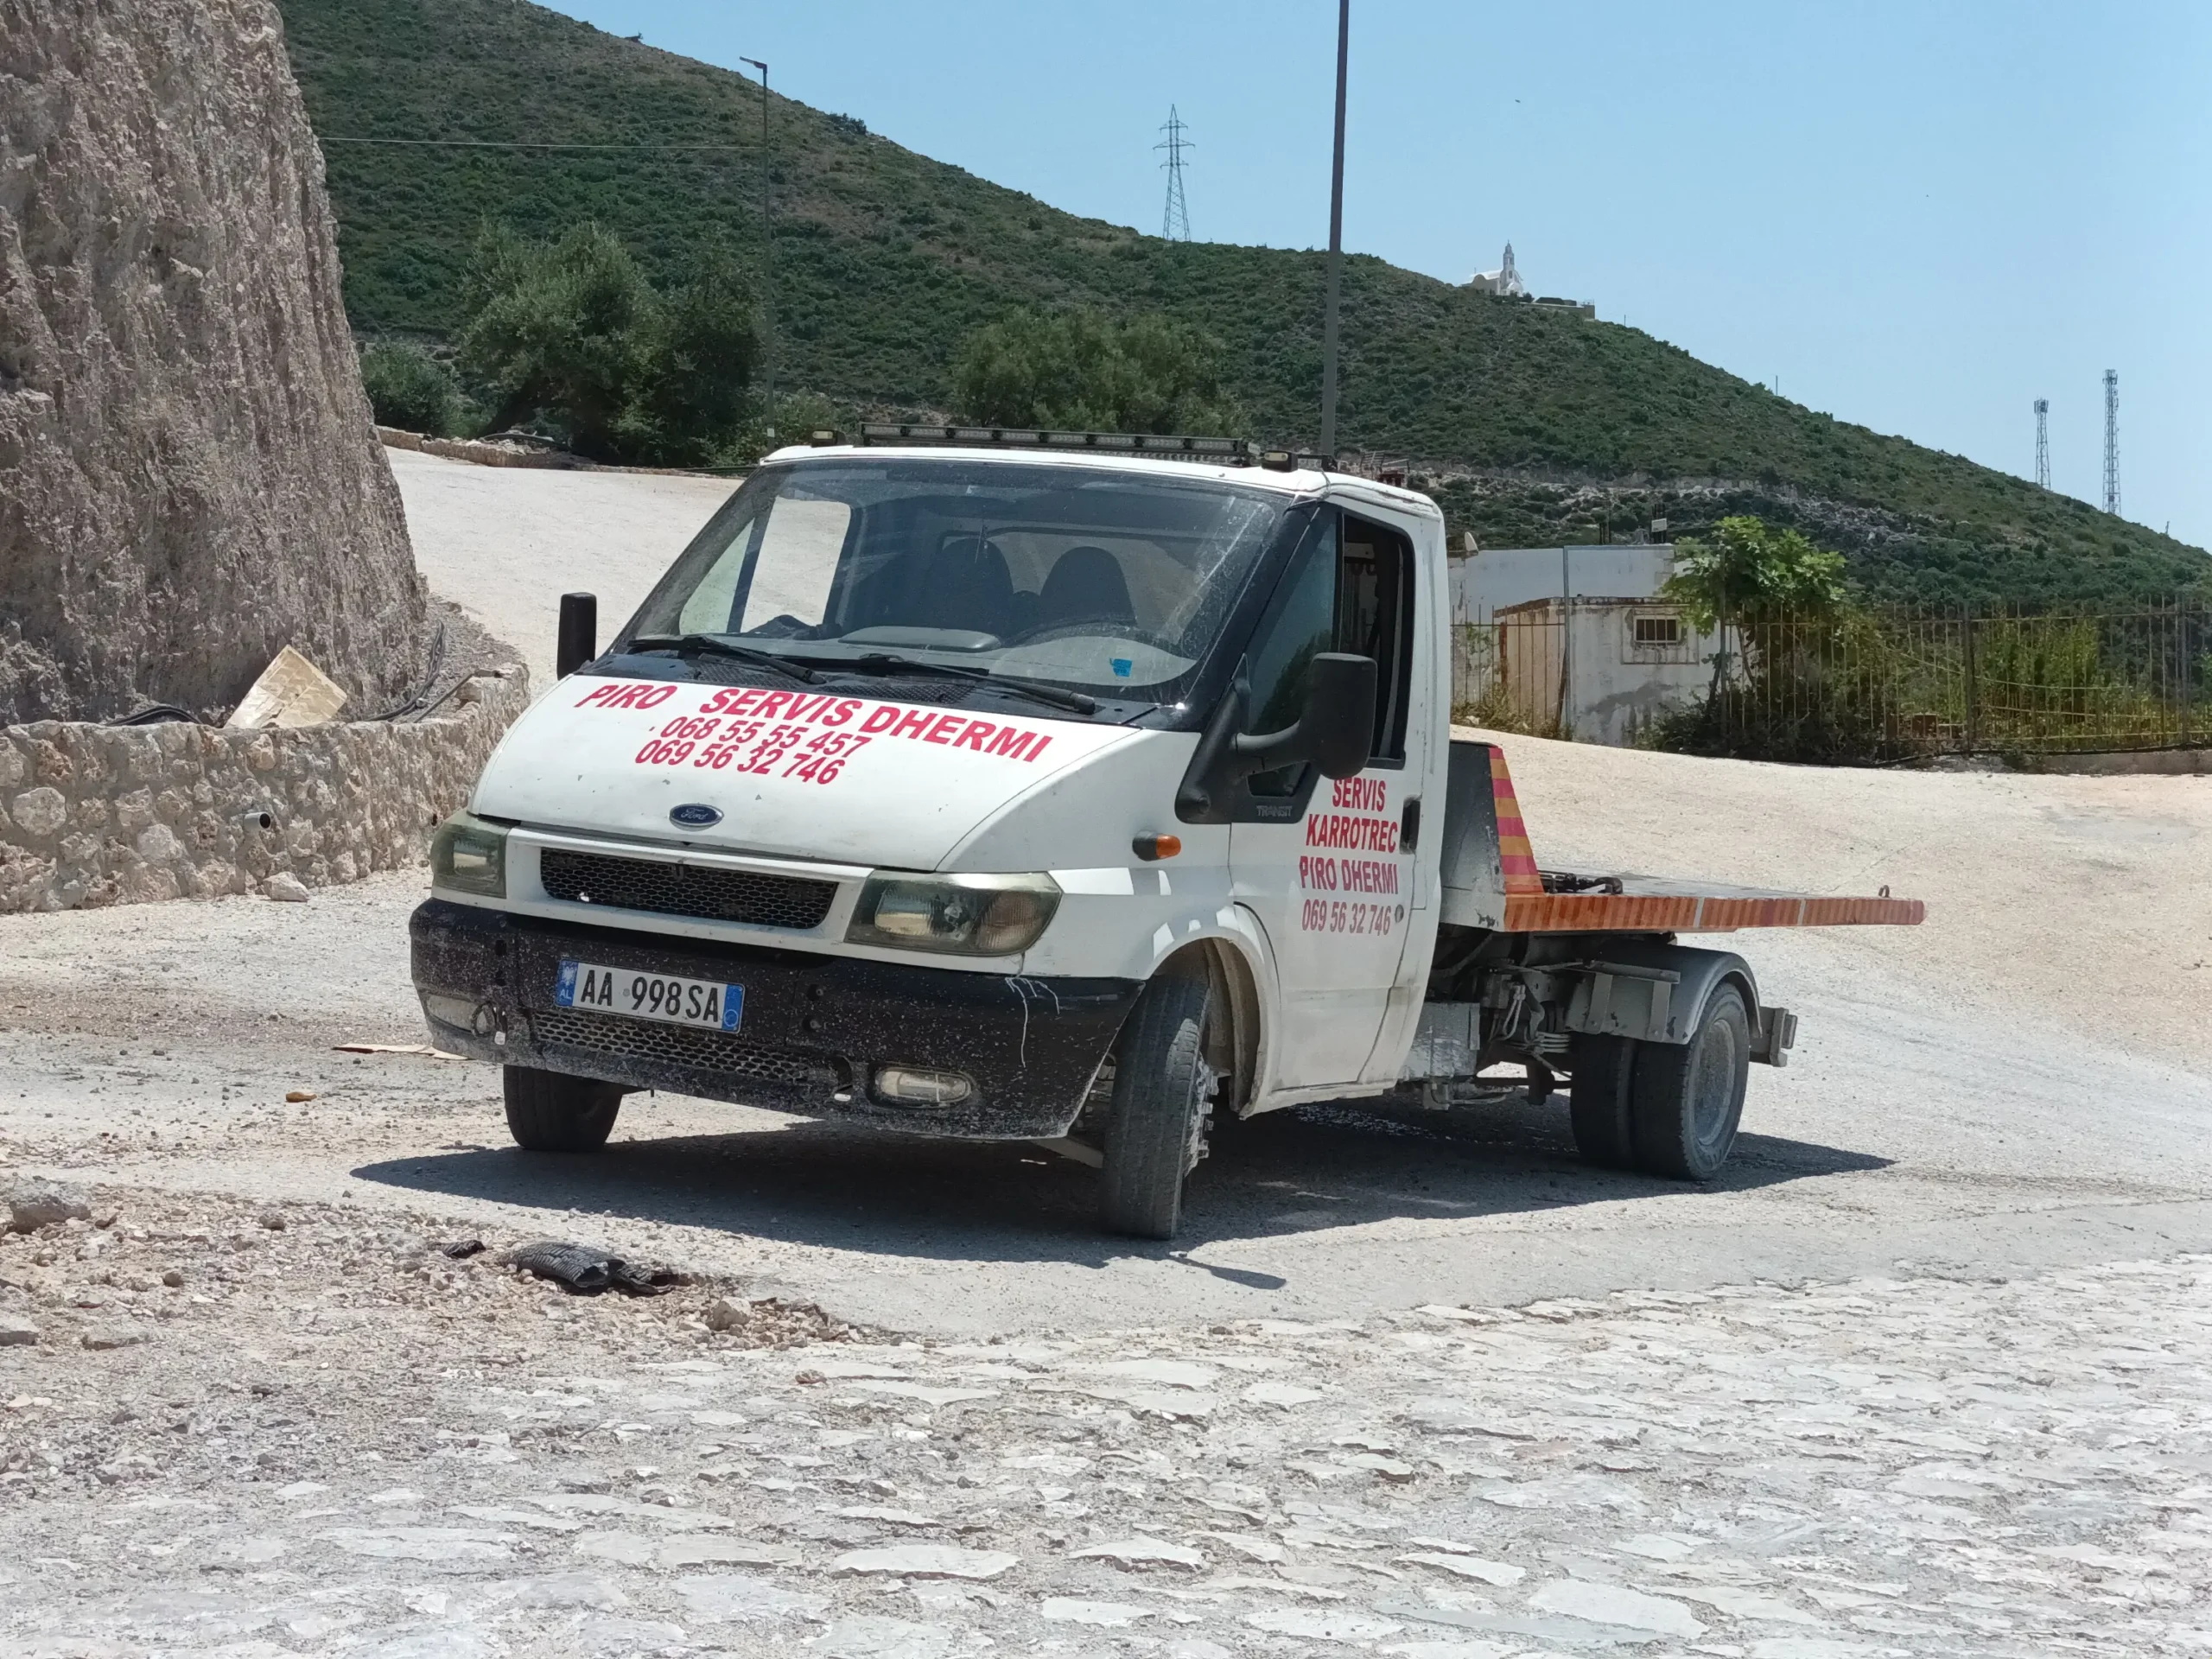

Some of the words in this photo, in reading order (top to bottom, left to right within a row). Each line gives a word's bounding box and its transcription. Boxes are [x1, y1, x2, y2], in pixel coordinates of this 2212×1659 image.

[574, 684, 677, 709] PIRO
[699, 688, 865, 728] SERVIS
[858, 705, 1052, 763] DHERMI
[660, 716, 721, 740] 068
[718, 720, 766, 743] 55
[761, 724, 810, 748] 55
[805, 731, 873, 759] 457
[634, 740, 696, 766] 069
[694, 743, 740, 769] 56
[736, 746, 784, 775] 32
[781, 753, 846, 785] 746
[1332, 777, 1386, 811] SERVIS
[680, 807, 709, 820] Ford
[1306, 813, 1398, 853] KARROTREC
[1299, 855, 1337, 891] PIRO
[1341, 859, 1398, 894] DHERMI
[1301, 899, 1327, 931] 069
[1330, 901, 1347, 932] 56
[1349, 903, 1366, 934] 32
[1368, 904, 1391, 936] 746
[559, 988, 572, 1000] AL
[581, 969, 613, 1007] AA
